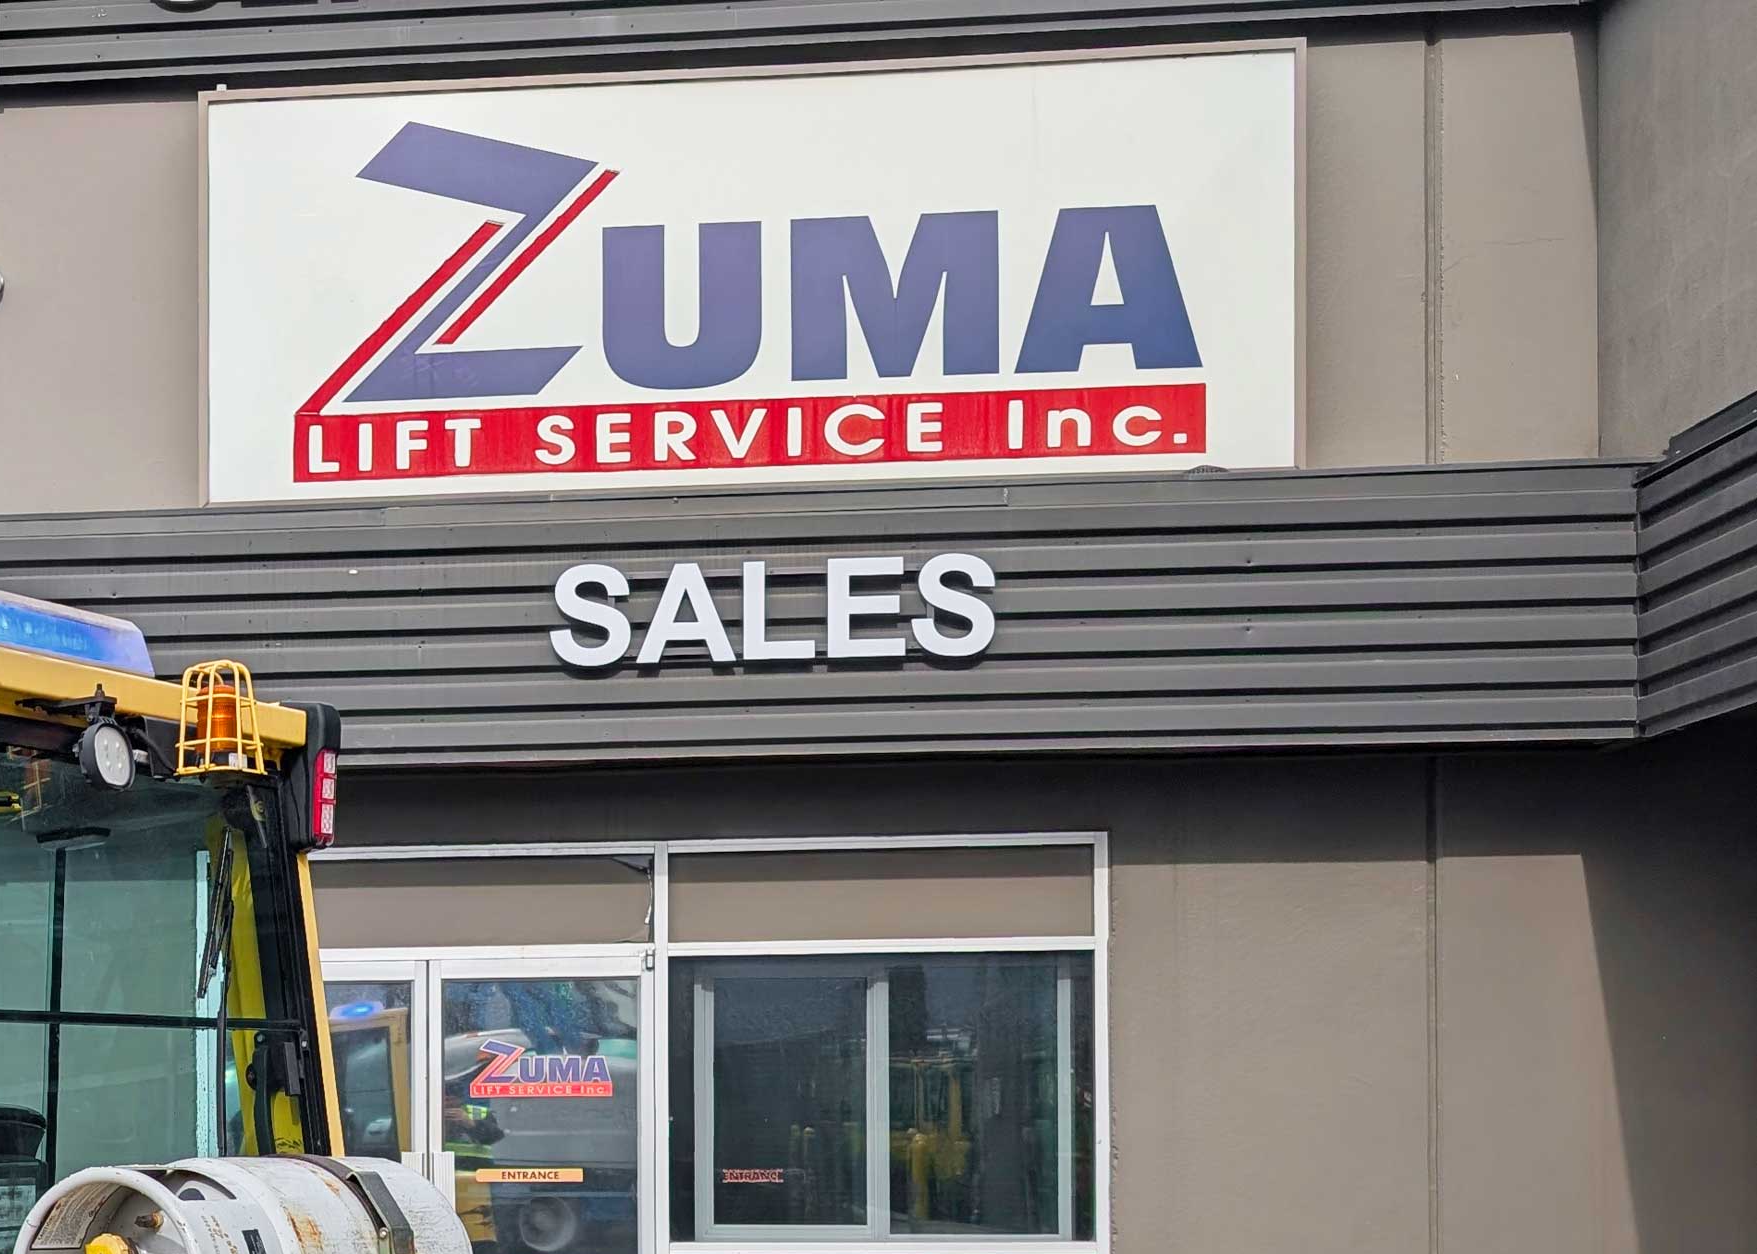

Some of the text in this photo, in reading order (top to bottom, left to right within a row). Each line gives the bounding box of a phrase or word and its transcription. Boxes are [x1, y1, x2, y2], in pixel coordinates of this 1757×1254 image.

[298, 121, 1202, 412] ZUMA
[308, 398, 1188, 476] LIFT SERVICE Inc.
[550, 552, 996, 668] SALES
[473, 1085, 501, 1095] LIFT
[509, 1085, 572, 1095] SERVICE
[474, 1039, 612, 1083] ZUMA
[501, 1171, 560, 1180] ENTRANCE
